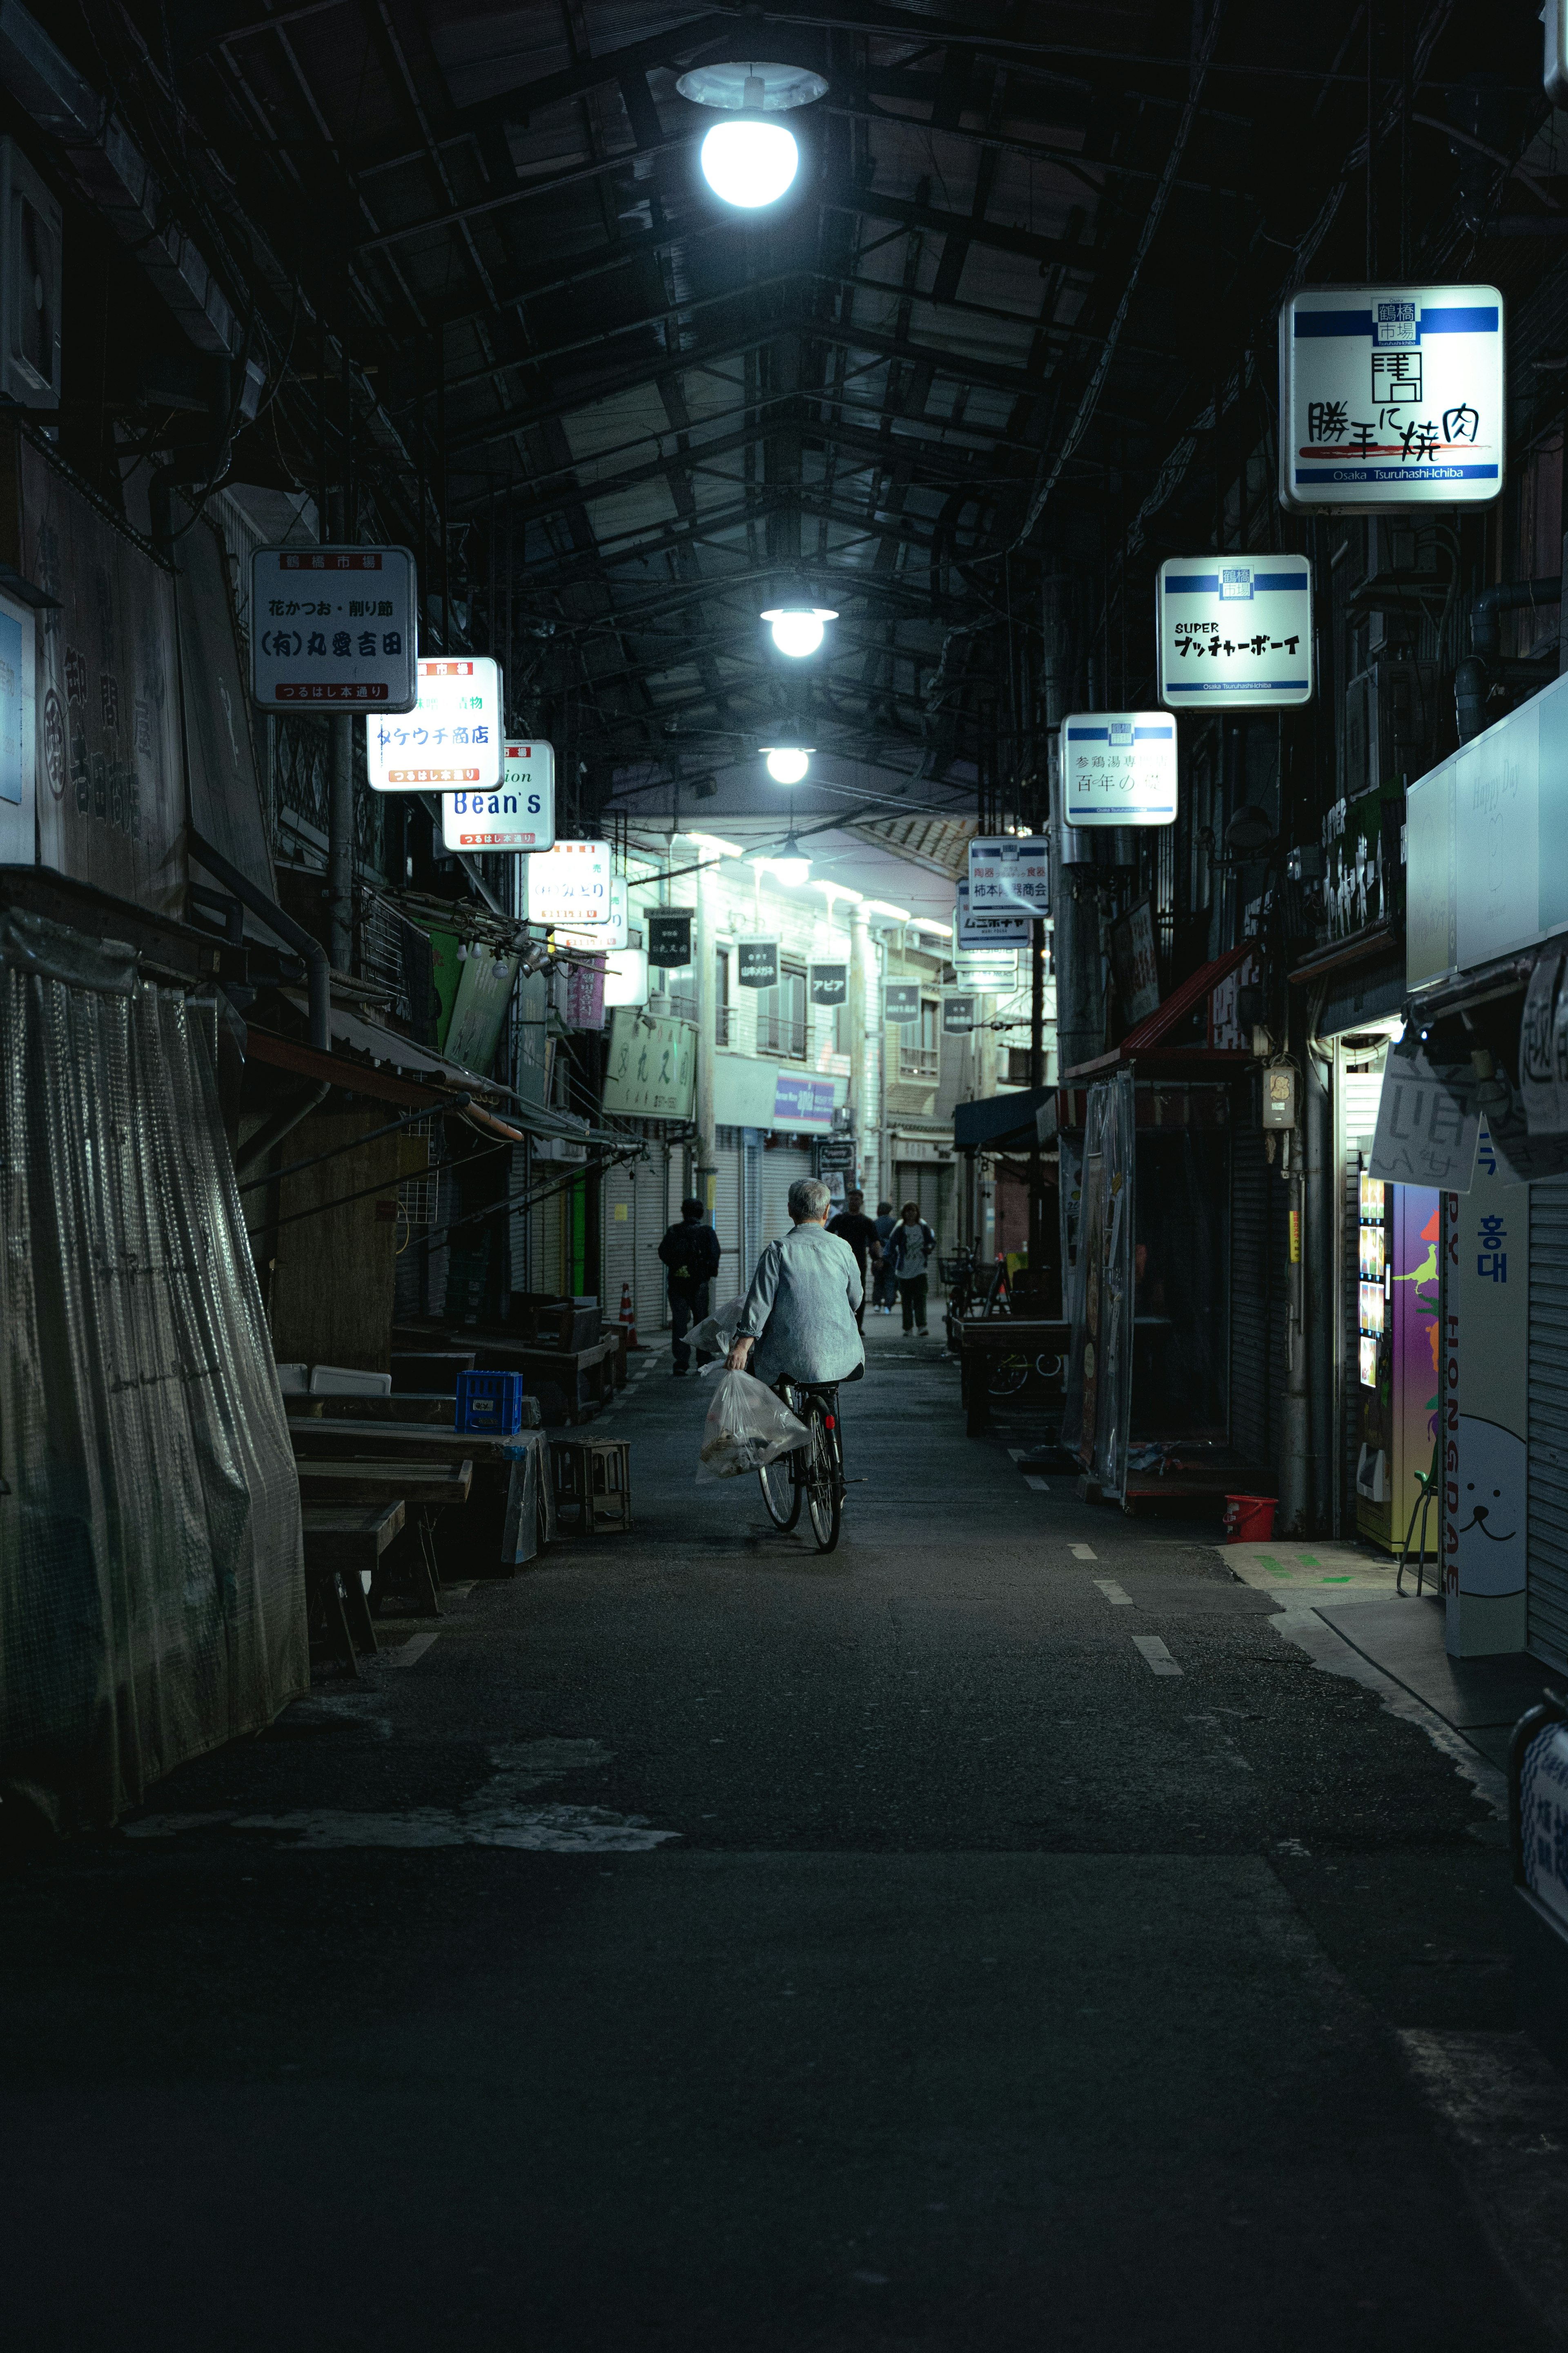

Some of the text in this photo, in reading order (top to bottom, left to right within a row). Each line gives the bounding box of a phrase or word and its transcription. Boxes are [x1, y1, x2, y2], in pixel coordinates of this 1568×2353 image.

[1379, 304, 1414, 321] 鶴橋
[1380, 323, 1414, 340] 市場
[1308, 401, 1479, 462] 勝手に焼肉
[1333, 468, 1463, 480] Osaka Tsuruhashi-Ichiba
[286, 555, 376, 569] 鶴橋市場
[1223, 569, 1250, 582] 鶴橋
[1224, 583, 1250, 596] 市場
[268, 599, 394, 617] 花かつお・削り節
[1175, 622, 1219, 633] SUPER
[261, 630, 402, 657] (有)丸愛吉田
[1174, 634, 1300, 657] ブッチャーボーイ
[283, 686, 381, 698] つるはし本通り
[377, 725, 489, 746] タケウチ商店
[394, 768, 474, 781] つるはし本通り
[454, 792, 541, 814] Bean's
[464, 834, 531, 843] つるはし本通り
[974, 883, 1047, 897] 柿本器商会
[813, 979, 844, 991] アピア
[1477, 1214, 1507, 1283] 홍대
[1446, 1316, 1459, 1598] HONGDAE
